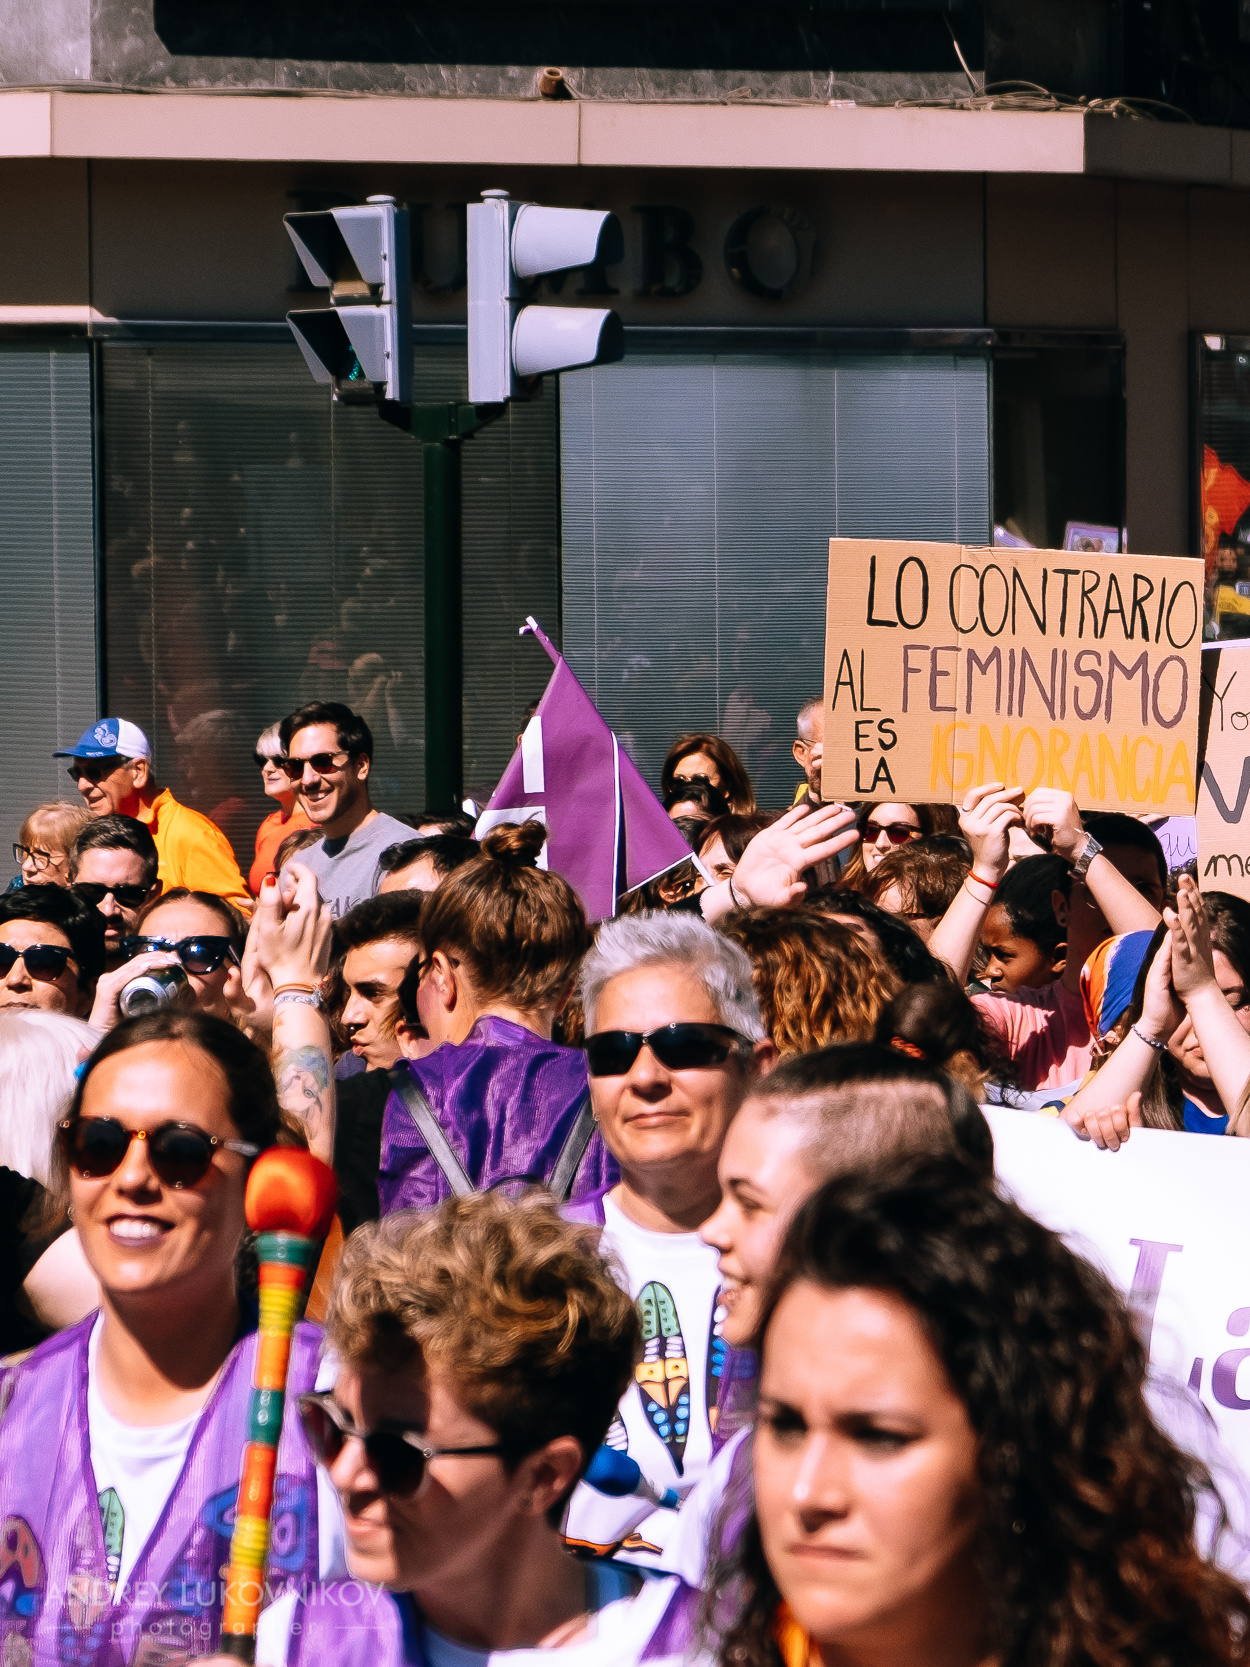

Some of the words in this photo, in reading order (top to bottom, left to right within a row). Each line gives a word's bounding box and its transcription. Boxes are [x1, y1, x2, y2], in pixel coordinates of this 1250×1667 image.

[866, 554, 930, 630] LO
[949, 564, 1198, 649] CONTRARIO
[832, 648, 882, 713] AL
[902, 644, 1189, 729] FEMINISMO
[855, 718, 898, 752] ES
[855, 756, 896, 794] LA
[929, 721, 1196, 804] IGNORANCIA
